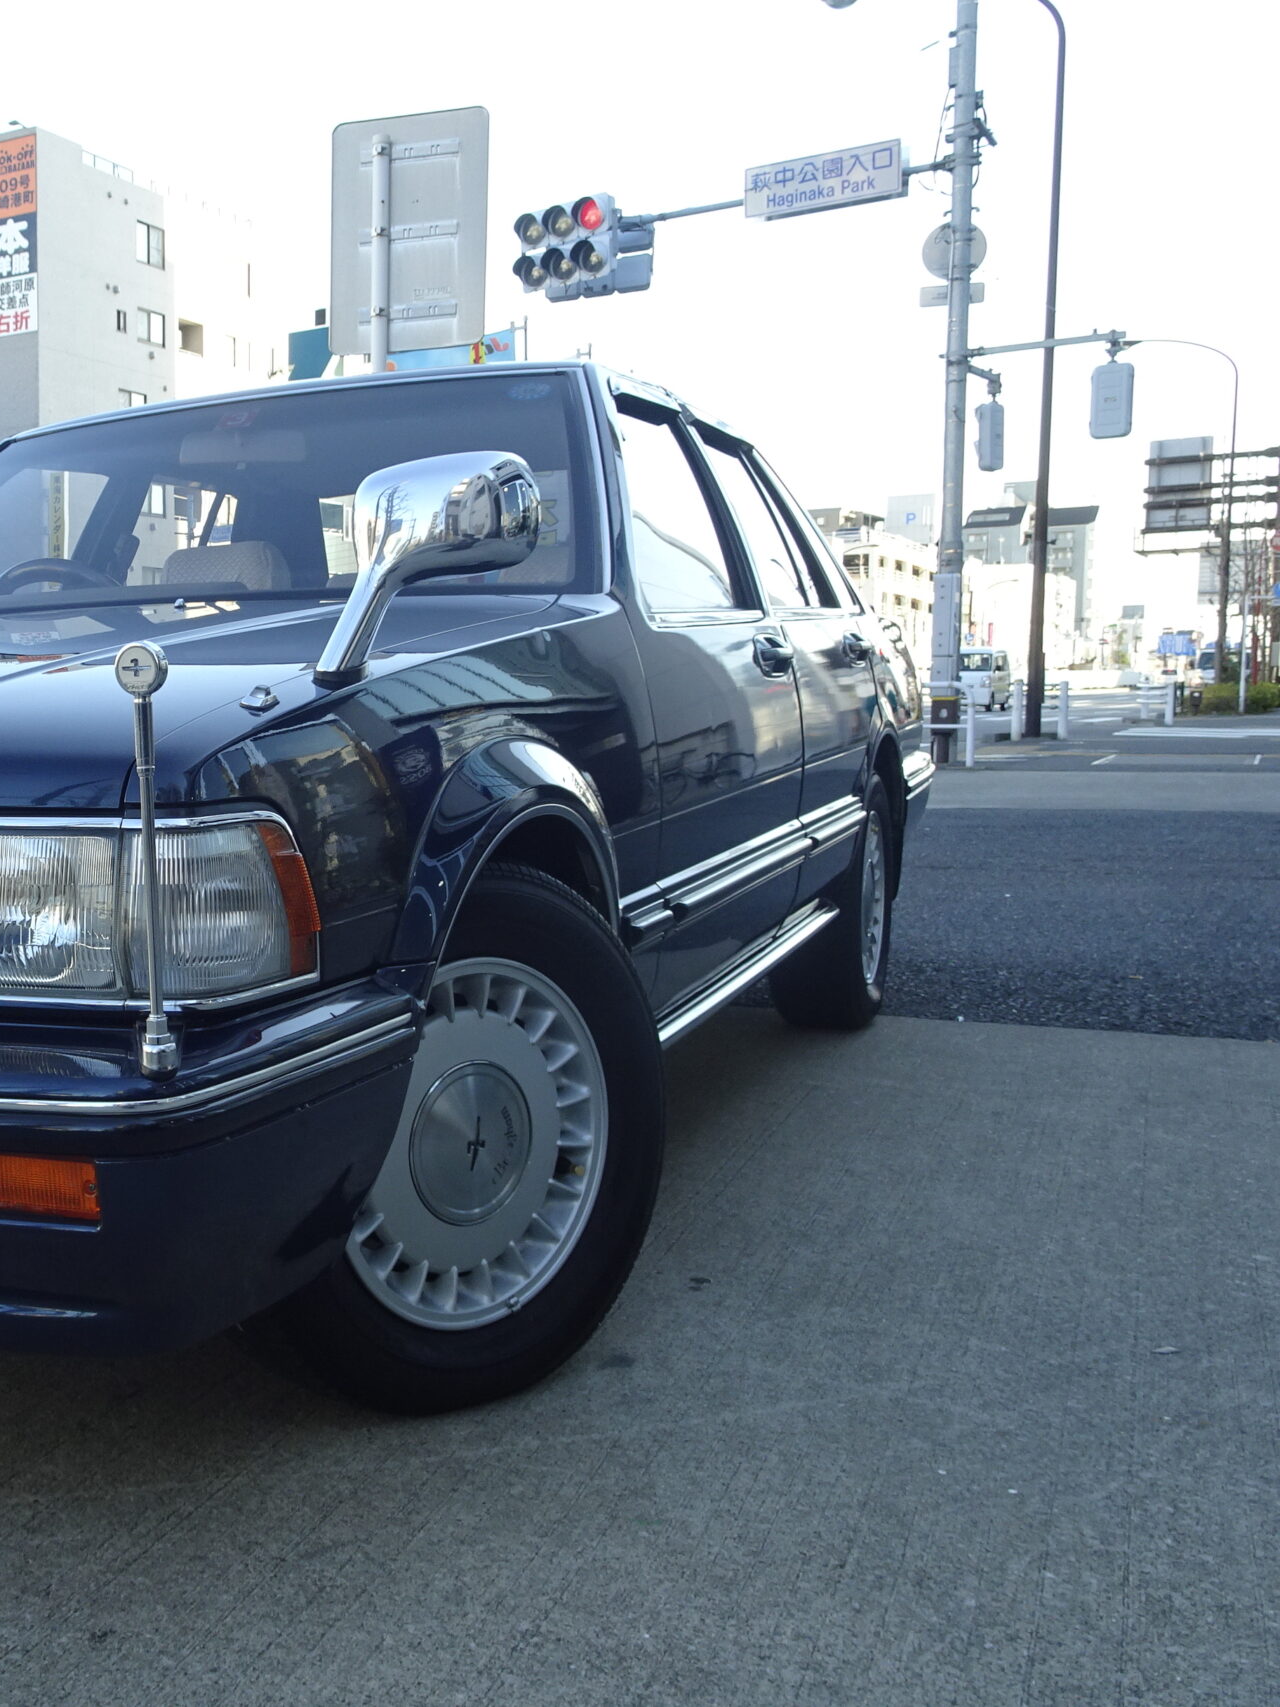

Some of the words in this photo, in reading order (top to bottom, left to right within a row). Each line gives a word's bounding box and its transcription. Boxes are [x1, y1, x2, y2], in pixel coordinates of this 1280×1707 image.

[751, 148, 893, 193] 萩中公園入口
[766, 183, 835, 209] Haginaka
[841, 176, 876, 195] Park
[905, 512, 917, 525] P
